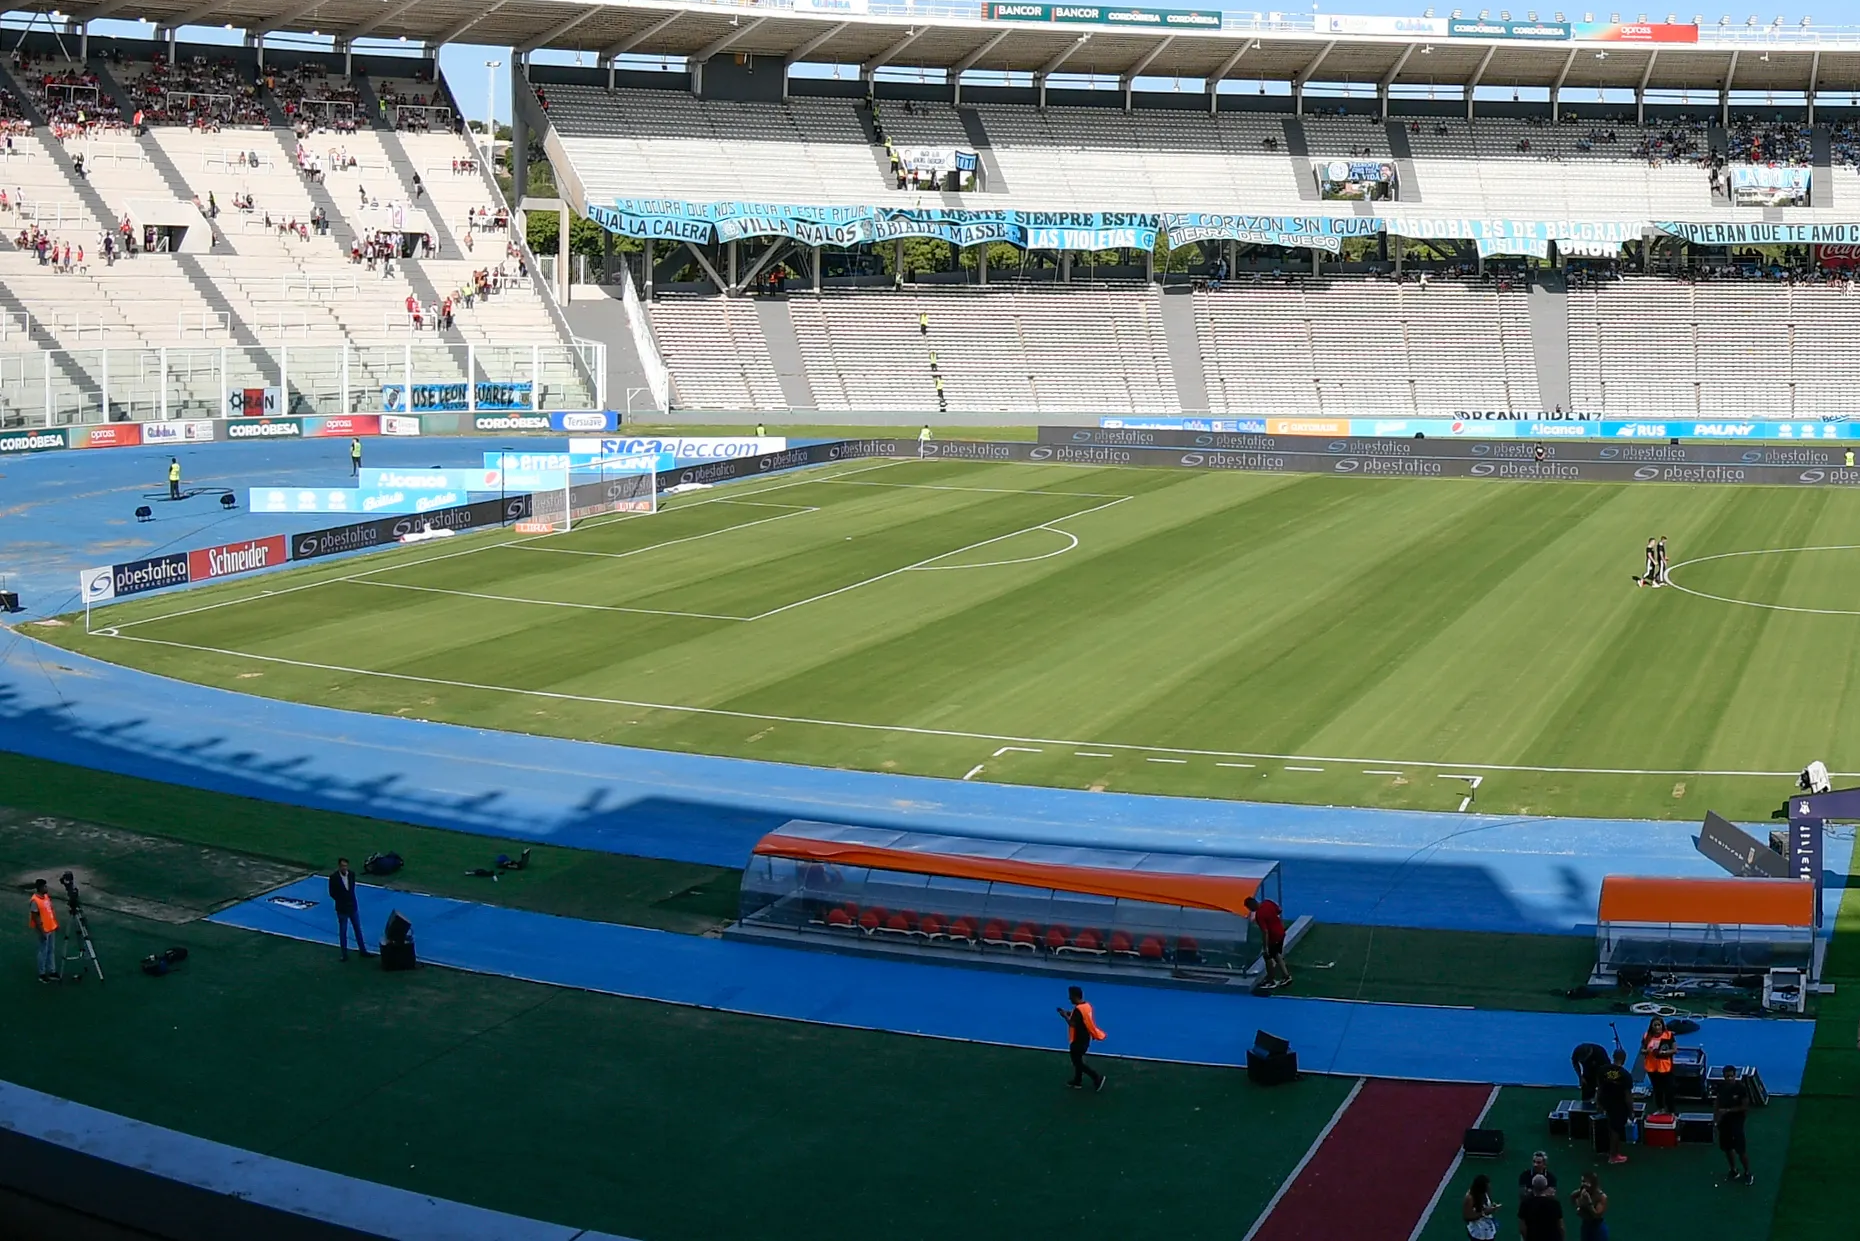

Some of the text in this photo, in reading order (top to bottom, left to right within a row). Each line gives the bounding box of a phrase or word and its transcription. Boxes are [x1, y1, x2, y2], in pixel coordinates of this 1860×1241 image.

[998, 5, 1042, 17] BANCOR
[1055, 7, 1099, 19] BANCOR
[687, 203, 708, 217] QUE
[714, 202, 737, 219] NOS
[742, 203, 778, 219] LLEVA
[797, 206, 826, 221] ESTE
[832, 205, 873, 223] RITUAL
[940, 209, 1160, 228] MENTE SIEMPRE ESTAS
[588, 206, 708, 242] FILIAL LA CALERA
[738, 217, 857, 244] VILLA AVALOS
[1164, 213, 1377, 235] DE CORAZON SIN IGUAL
[1387, 219, 1643, 241] CORDOBA ES DE BELGRANO
[950, 223, 1006, 244] MASSE
[1030, 230, 1136, 249] LAS VIOLETAS
[1170, 227, 1342, 250] TIERRA DEL FUEGO
[1751, 224, 1781, 242] QUE
[1786, 225, 1807, 241] TE
[1812, 224, 1846, 242] AMO
[437, 384, 467, 405] LEON
[229, 422, 299, 437] CORDOBESA
[476, 417, 550, 430] CORDOBESA
[567, 416, 602, 428] Tersuave
[1531, 423, 1584, 436] Alcance
[1094, 429, 1154, 443] pbestatica
[1638, 425, 1666, 436] RUS
[1694, 424, 1755, 436] PAUNY
[0, 435, 64, 451] CORDOBESA
[602, 439, 758, 458] sicaelec.com
[841, 441, 895, 455] pbestatica
[1216, 434, 1275, 448] pbestatica
[1350, 441, 1410, 454] pbestatica
[942, 442, 1009, 457] pbestatica
[1057, 446, 1130, 461] pbestatica
[1623, 446, 1685, 459] pbestatica
[1766, 450, 1828, 463] pbestatica
[773, 451, 808, 466] pbestatica
[1209, 452, 1284, 467] pbestatica
[1364, 457, 1441, 472] pbestatica
[695, 464, 736, 482] pbestatica
[1500, 462, 1579, 476] pbestatica
[1664, 465, 1744, 480] pbestatica
[378, 471, 447, 488] Alcance
[321, 524, 377, 549] pbestatica
[209, 541, 269, 577] Schneider
[117, 560, 186, 589] pbestatica
